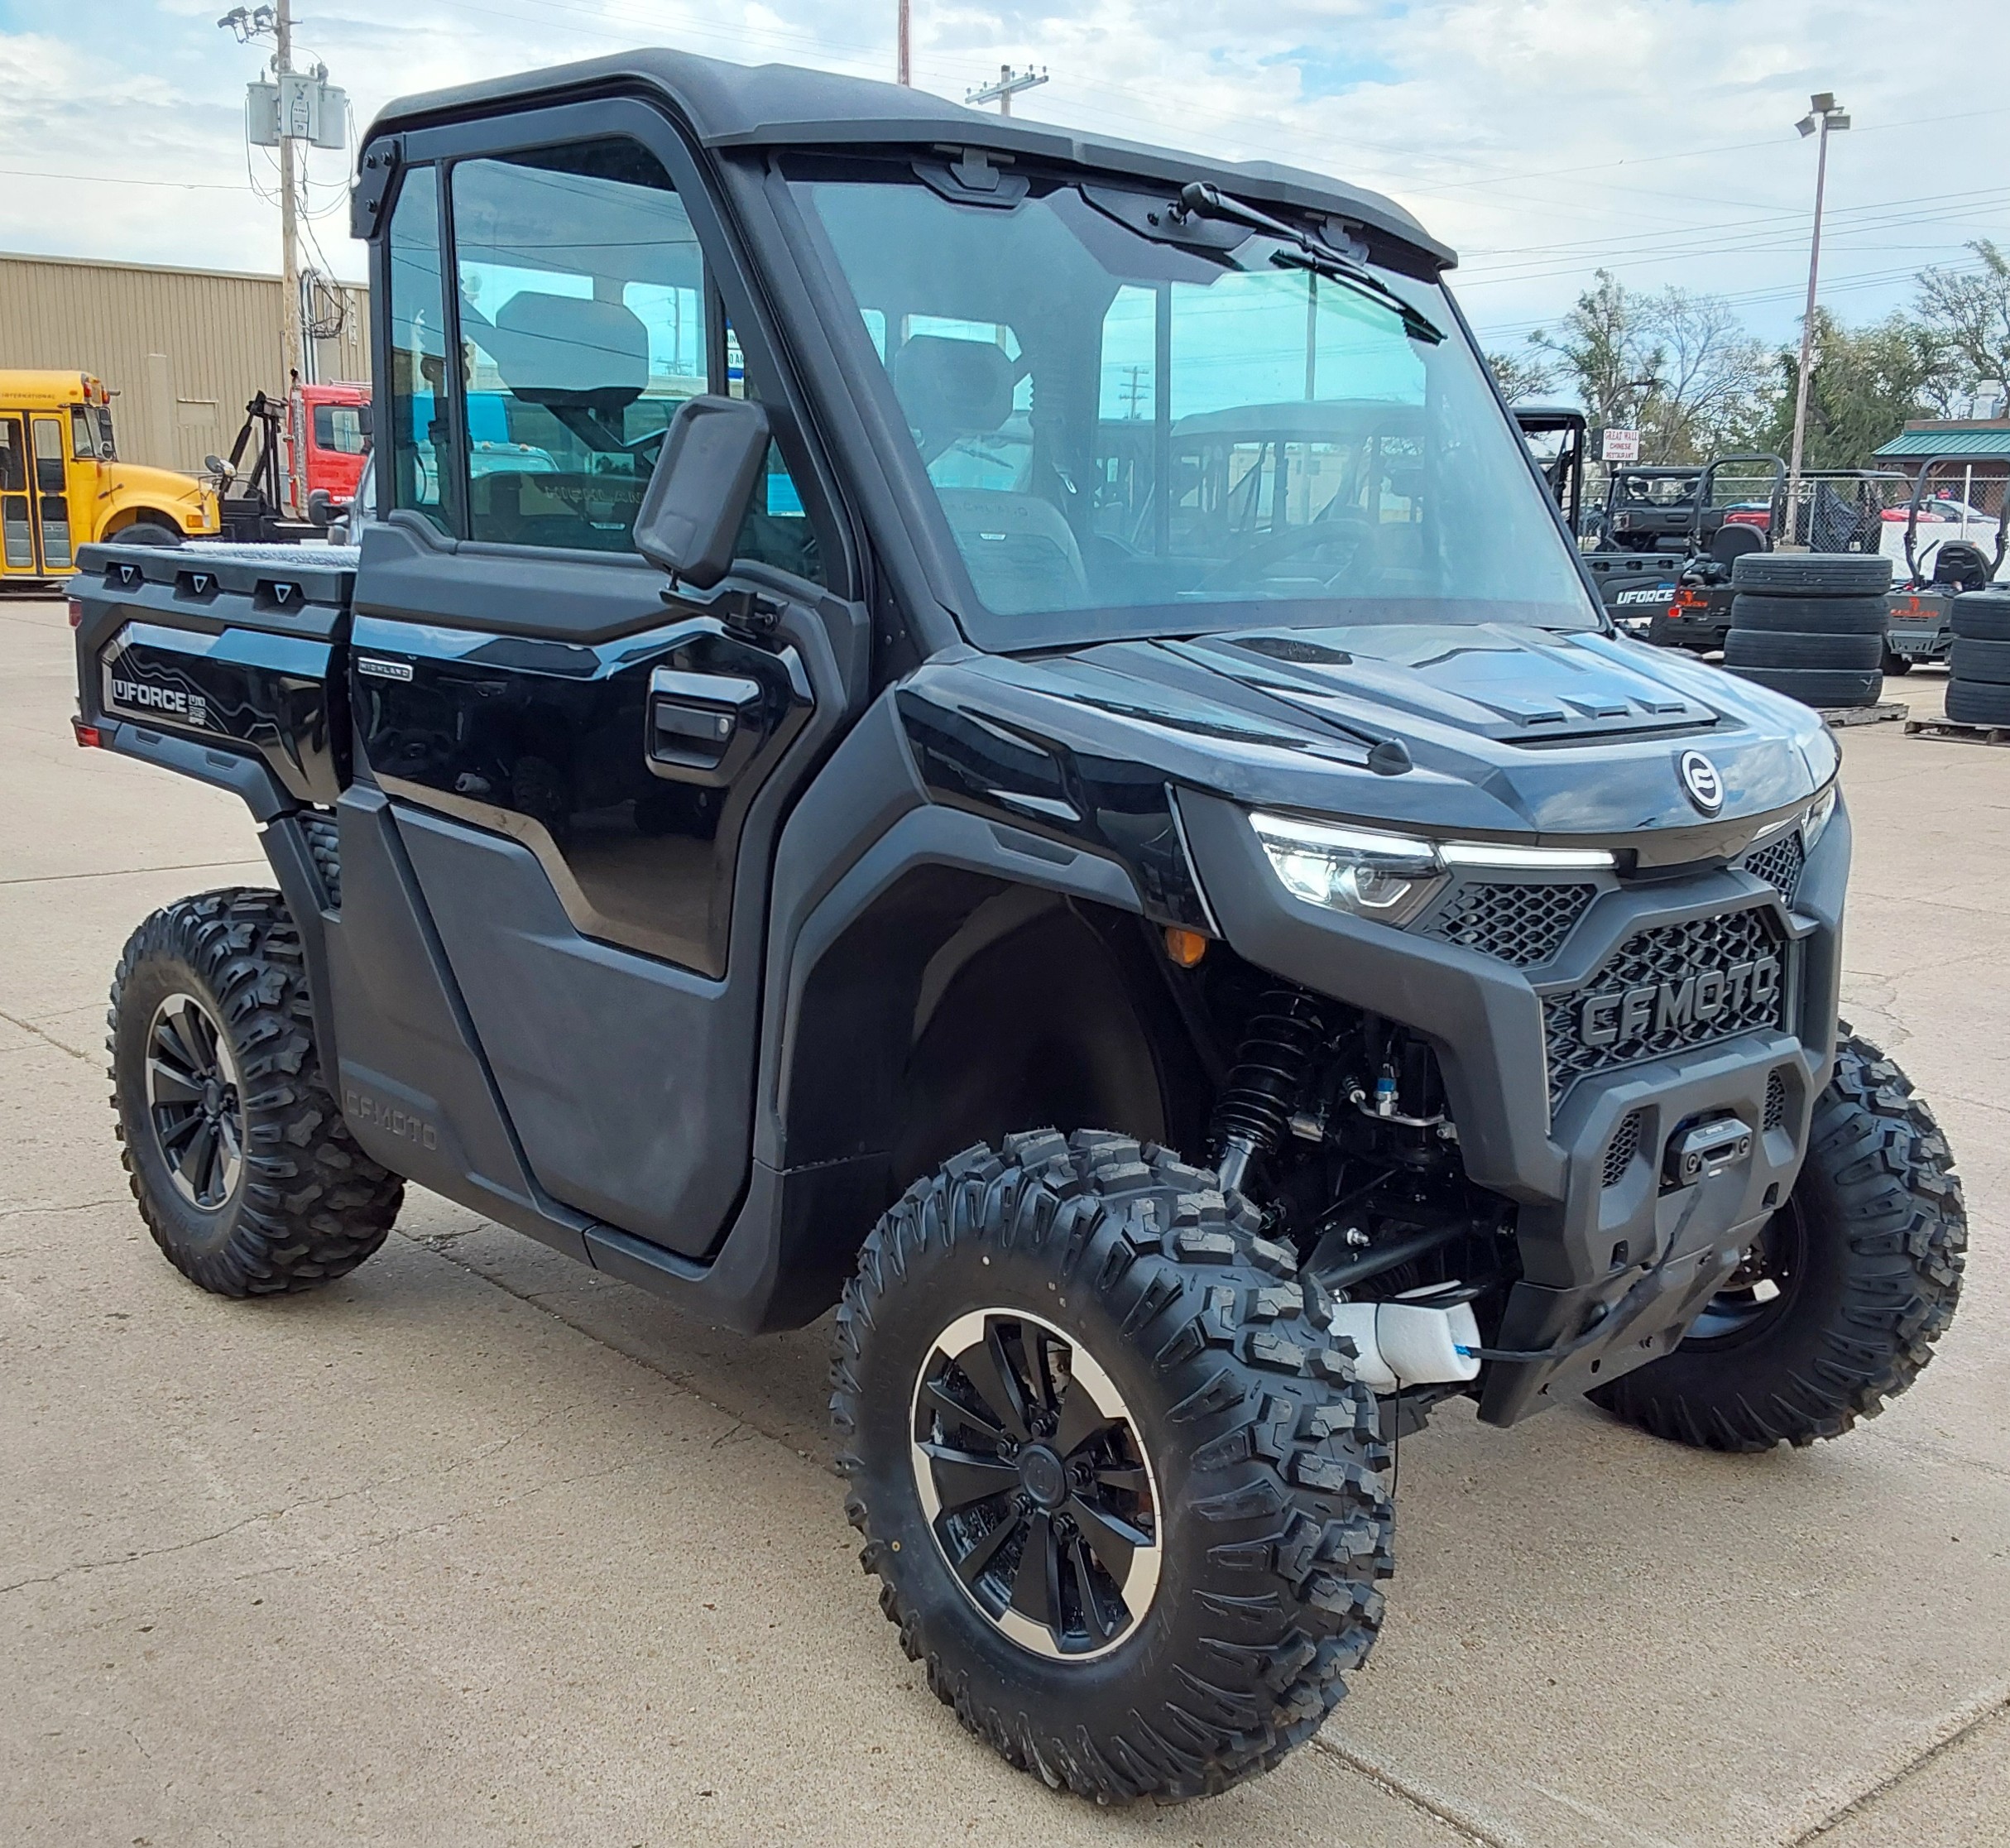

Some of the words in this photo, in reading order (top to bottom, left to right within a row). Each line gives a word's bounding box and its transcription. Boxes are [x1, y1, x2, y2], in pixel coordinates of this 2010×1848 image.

[1605, 430, 1622, 440] GREAT
[1624, 431, 1638, 440] WALL
[1616, 588, 1677, 605] UFORCE
[359, 662, 410, 677] HIGHLAND
[113, 679, 188, 713] UFORCE
[1581, 955, 1777, 1047] CFMOTO
[346, 1090, 437, 1150] CFMOTO
